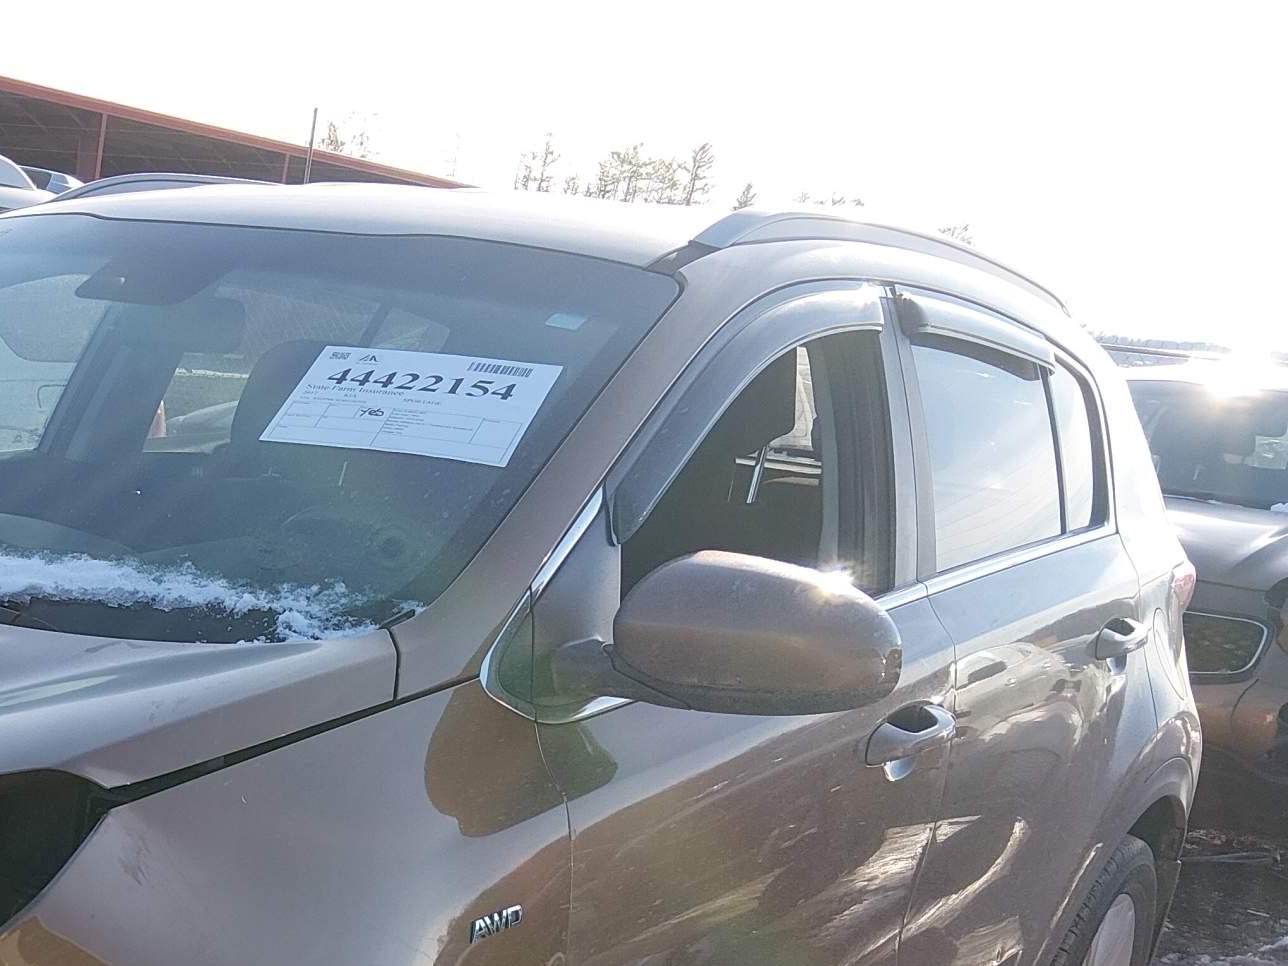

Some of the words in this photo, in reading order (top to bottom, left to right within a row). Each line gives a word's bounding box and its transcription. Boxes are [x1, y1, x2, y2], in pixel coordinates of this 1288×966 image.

[327, 368, 517, 401] 44422154
[332, 385, 357, 393] Farm
[359, 387, 405, 397] Insurance
[470, 904, 522, 944] AWD
